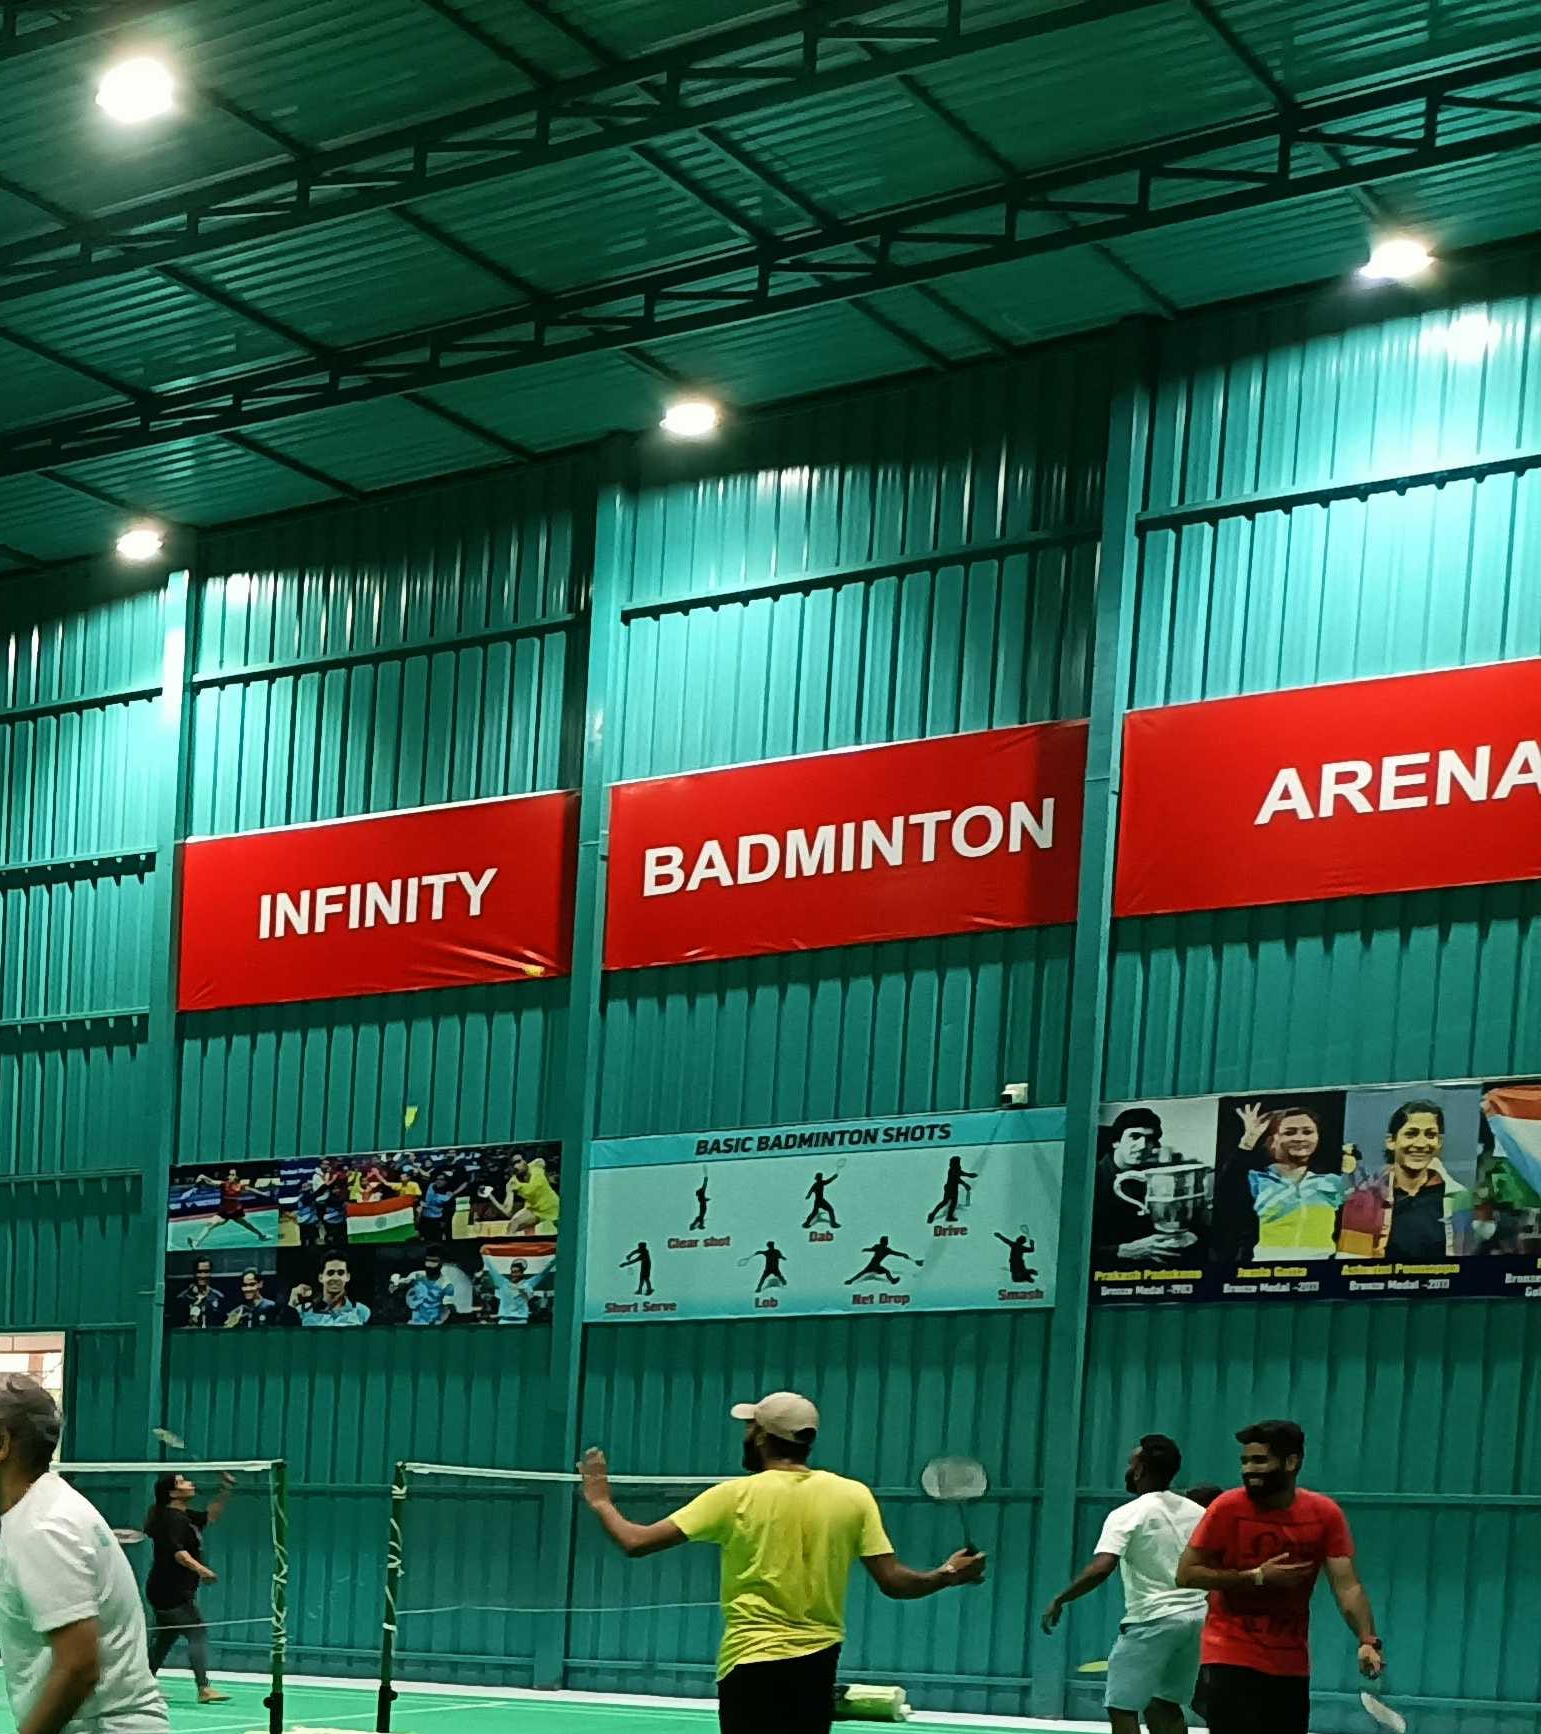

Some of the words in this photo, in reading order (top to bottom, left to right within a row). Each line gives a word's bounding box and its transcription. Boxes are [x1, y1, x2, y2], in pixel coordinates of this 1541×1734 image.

[260, 867, 497, 940] INFINITY
[643, 797, 1055, 897] BADMINTON
[1253, 739, 1541, 825] ARENA
[695, 1134, 755, 1156] BASIC
[756, 1127, 880, 1152] BADMINTON
[881, 1123, 952, 1144] SHOTS
[933, 1225, 968, 1237] Drive
[667, 1237, 699, 1249] Clear
[879, 1293, 910, 1306] Drop
[998, 1288, 1045, 1301] Smash
[643, 1301, 677, 1312] Serve
